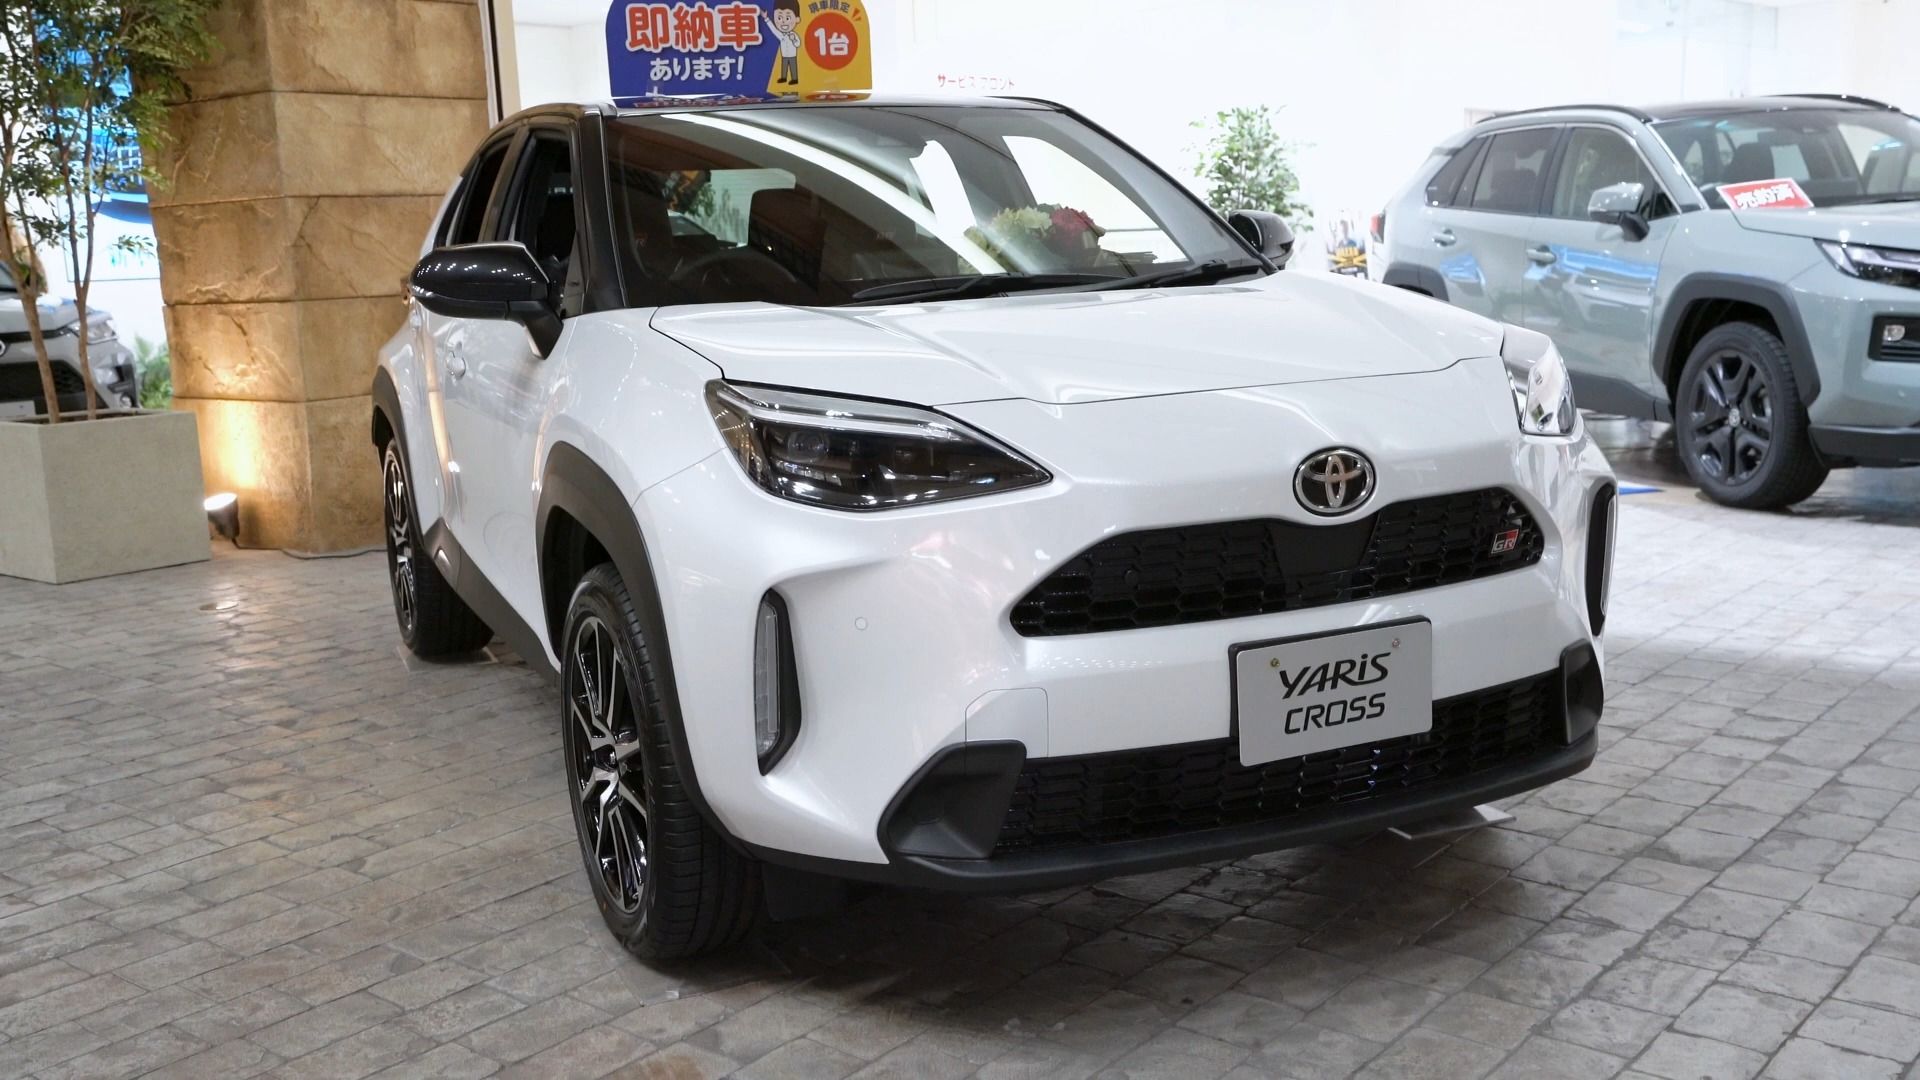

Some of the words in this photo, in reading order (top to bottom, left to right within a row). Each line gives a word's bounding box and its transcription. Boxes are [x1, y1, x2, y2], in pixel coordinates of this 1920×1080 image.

[627, 4, 761, 51] 即納車
[814, 28, 849, 56] 1台
[1493, 538, 1515, 551] GR
[1284, 692, 1386, 734] CROSS
